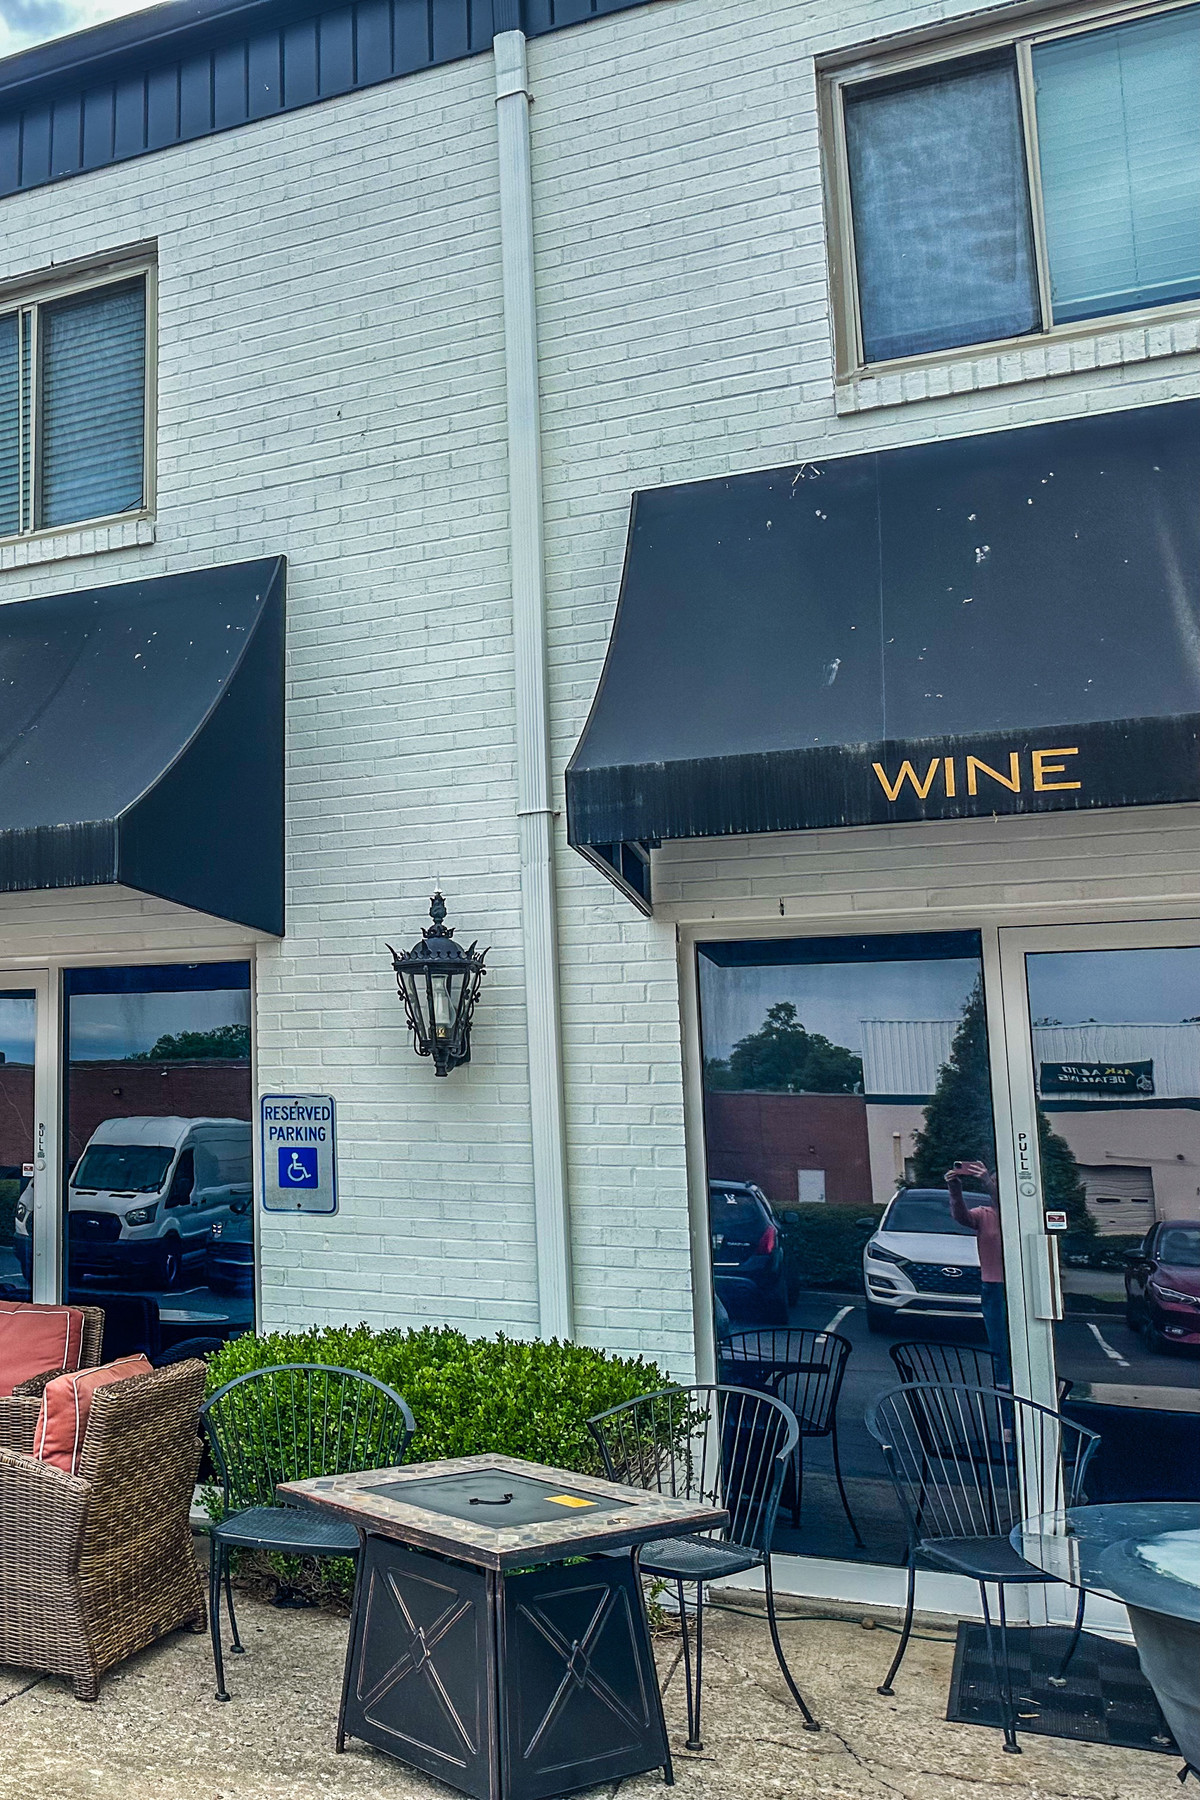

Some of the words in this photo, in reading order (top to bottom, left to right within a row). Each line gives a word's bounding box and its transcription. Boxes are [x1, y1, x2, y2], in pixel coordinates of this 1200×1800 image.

[872, 748, 1081, 801] WINE
[265, 1106, 330, 1120] RESERVED
[269, 1126, 326, 1141] PARKING
[1018, 1133, 1029, 1170] PULL
